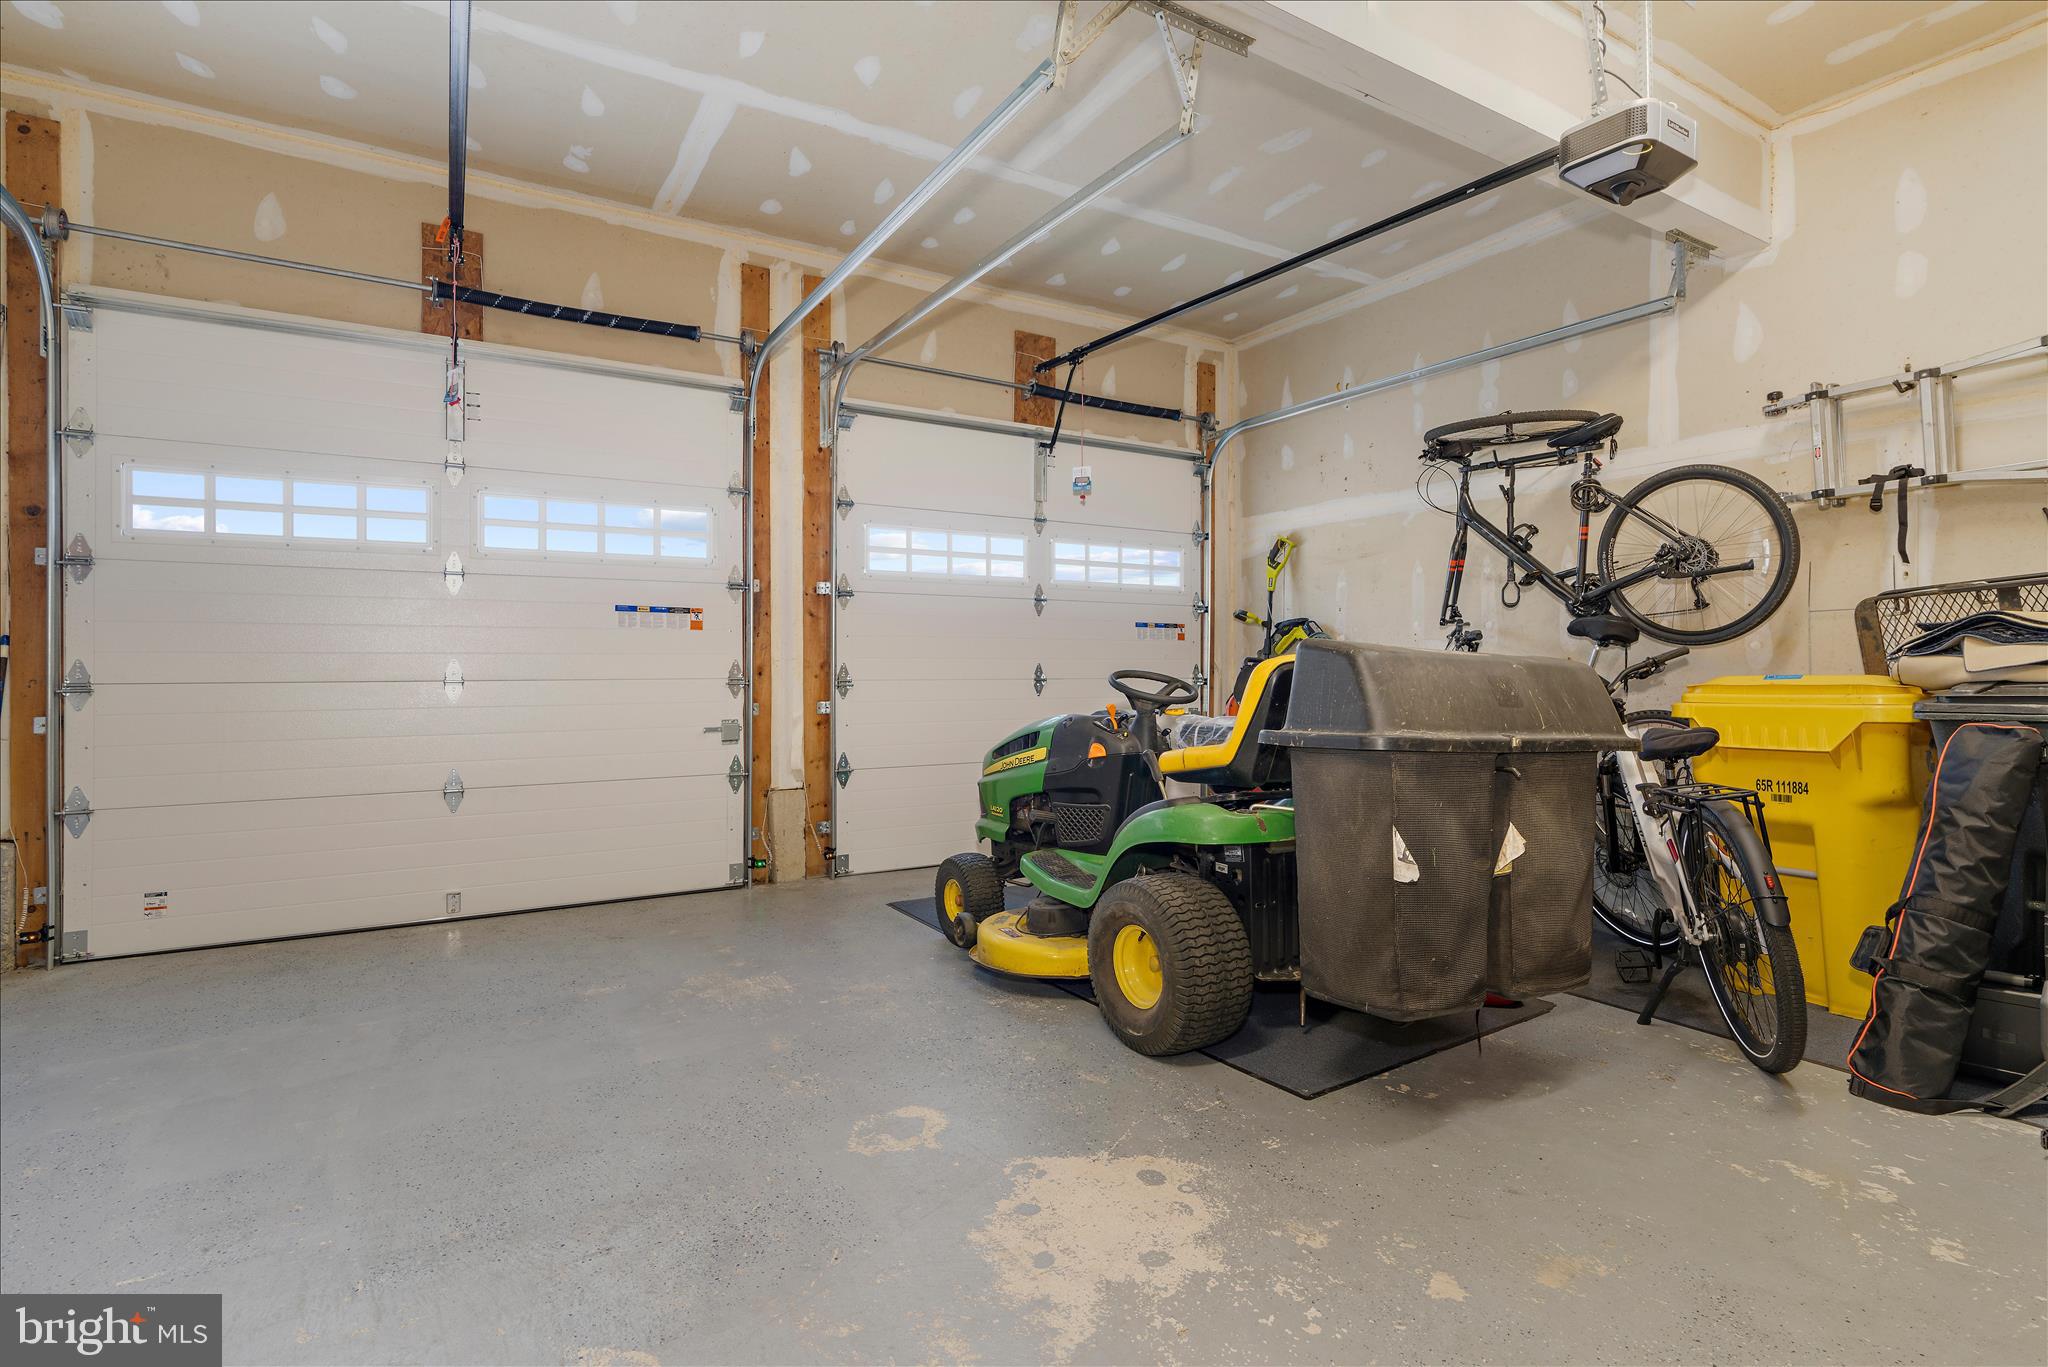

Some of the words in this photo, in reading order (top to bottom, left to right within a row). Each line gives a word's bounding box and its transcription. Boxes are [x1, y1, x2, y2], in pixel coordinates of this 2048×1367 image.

[1000, 759, 1015, 770] JOHN
[1015, 754, 1035, 766] DEERE
[1756, 778, 1773, 792] 65R
[1776, 780, 1809, 795] 111884
